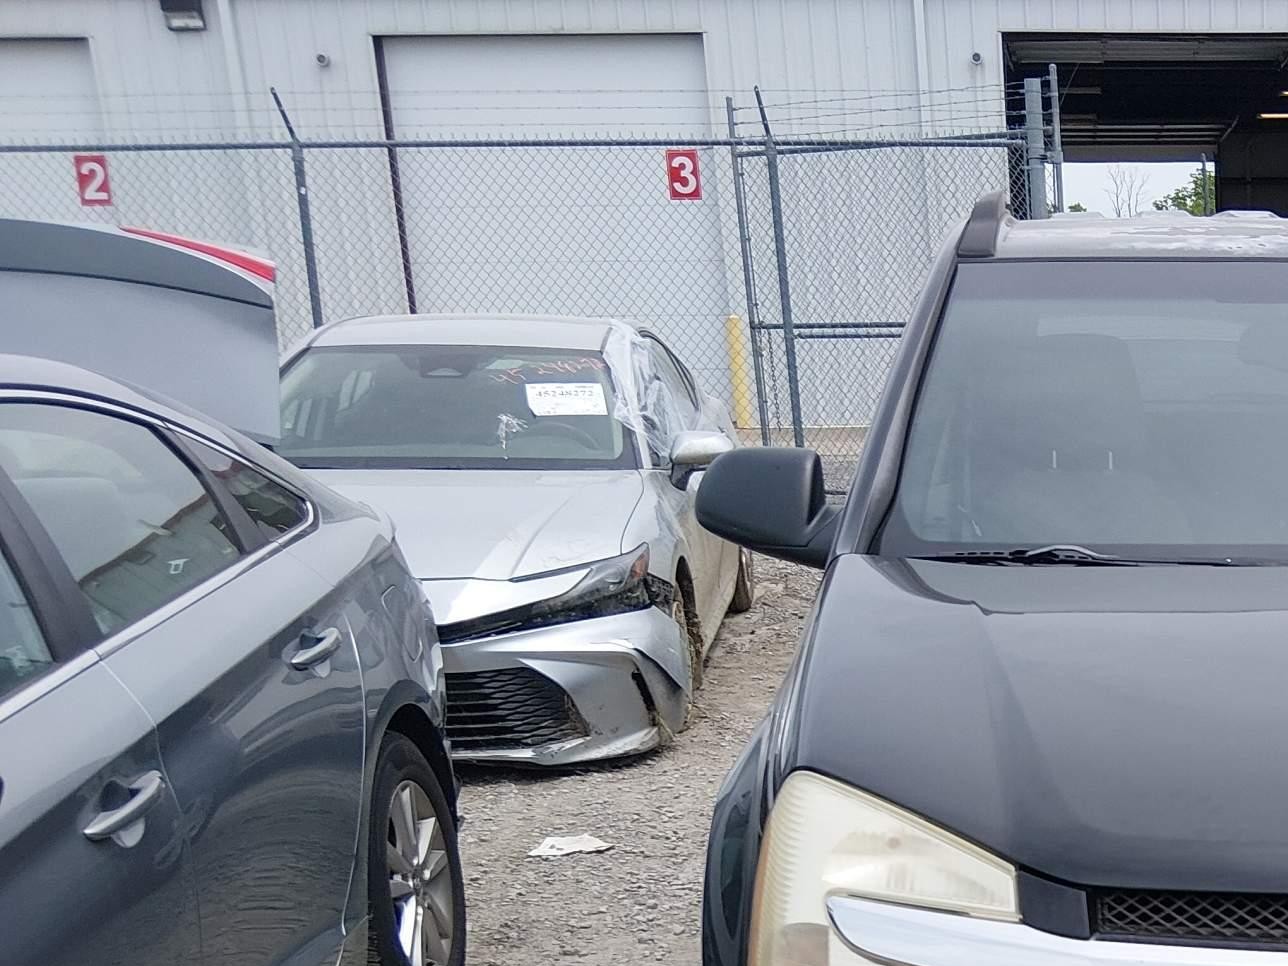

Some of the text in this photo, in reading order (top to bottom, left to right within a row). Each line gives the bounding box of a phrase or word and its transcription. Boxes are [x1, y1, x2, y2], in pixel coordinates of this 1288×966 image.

[81, 161, 109, 200] 2
[671, 156, 697, 194] 3
[536, 390, 594, 398] 45248272
